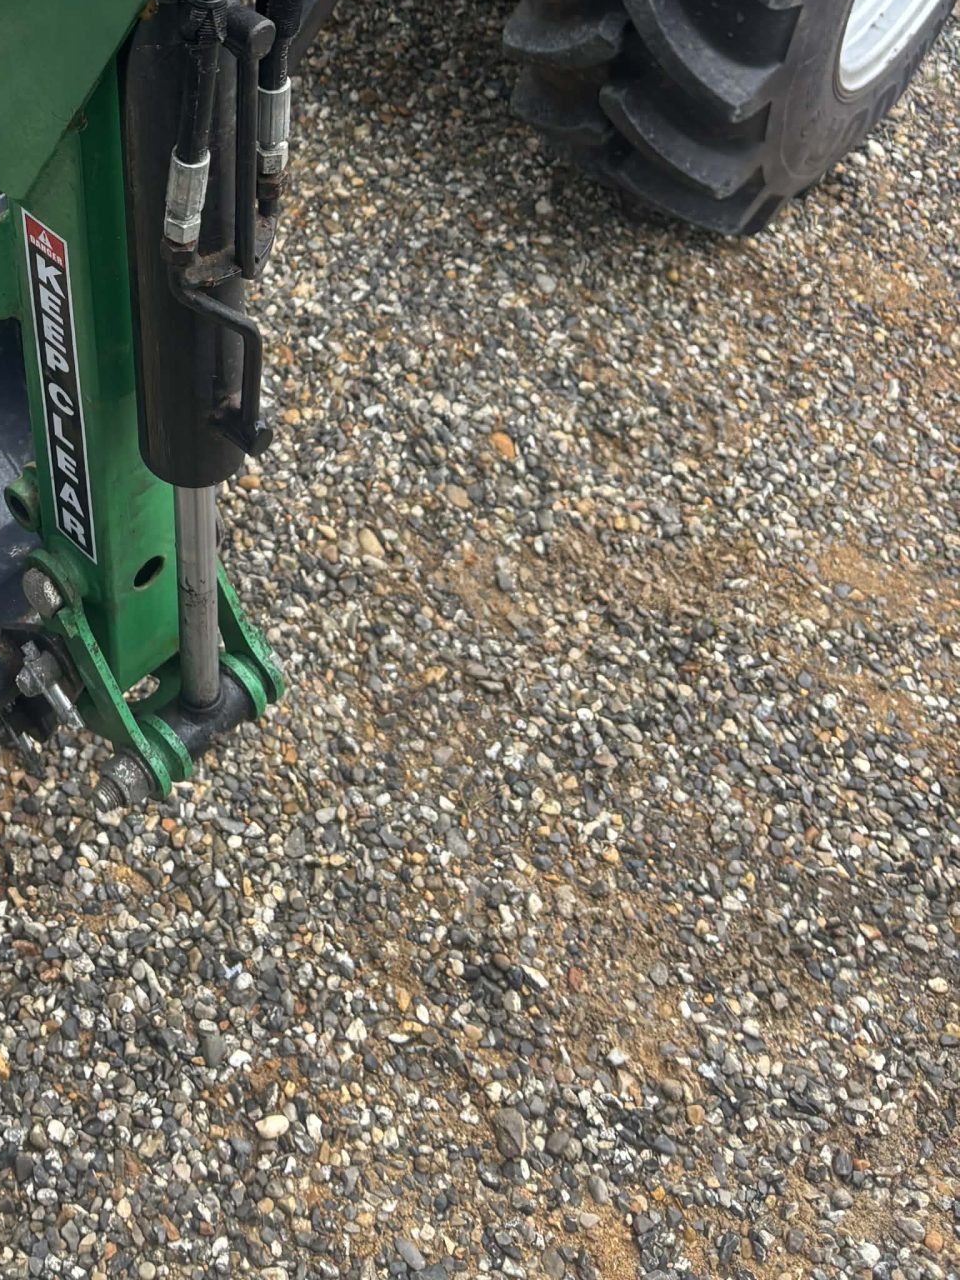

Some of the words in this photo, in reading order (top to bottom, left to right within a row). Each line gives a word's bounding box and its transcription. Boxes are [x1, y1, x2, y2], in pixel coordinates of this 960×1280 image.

[30, 234, 64, 269] DANGER
[36, 253, 69, 373] KEEP
[48, 382, 87, 547] CLEAR
